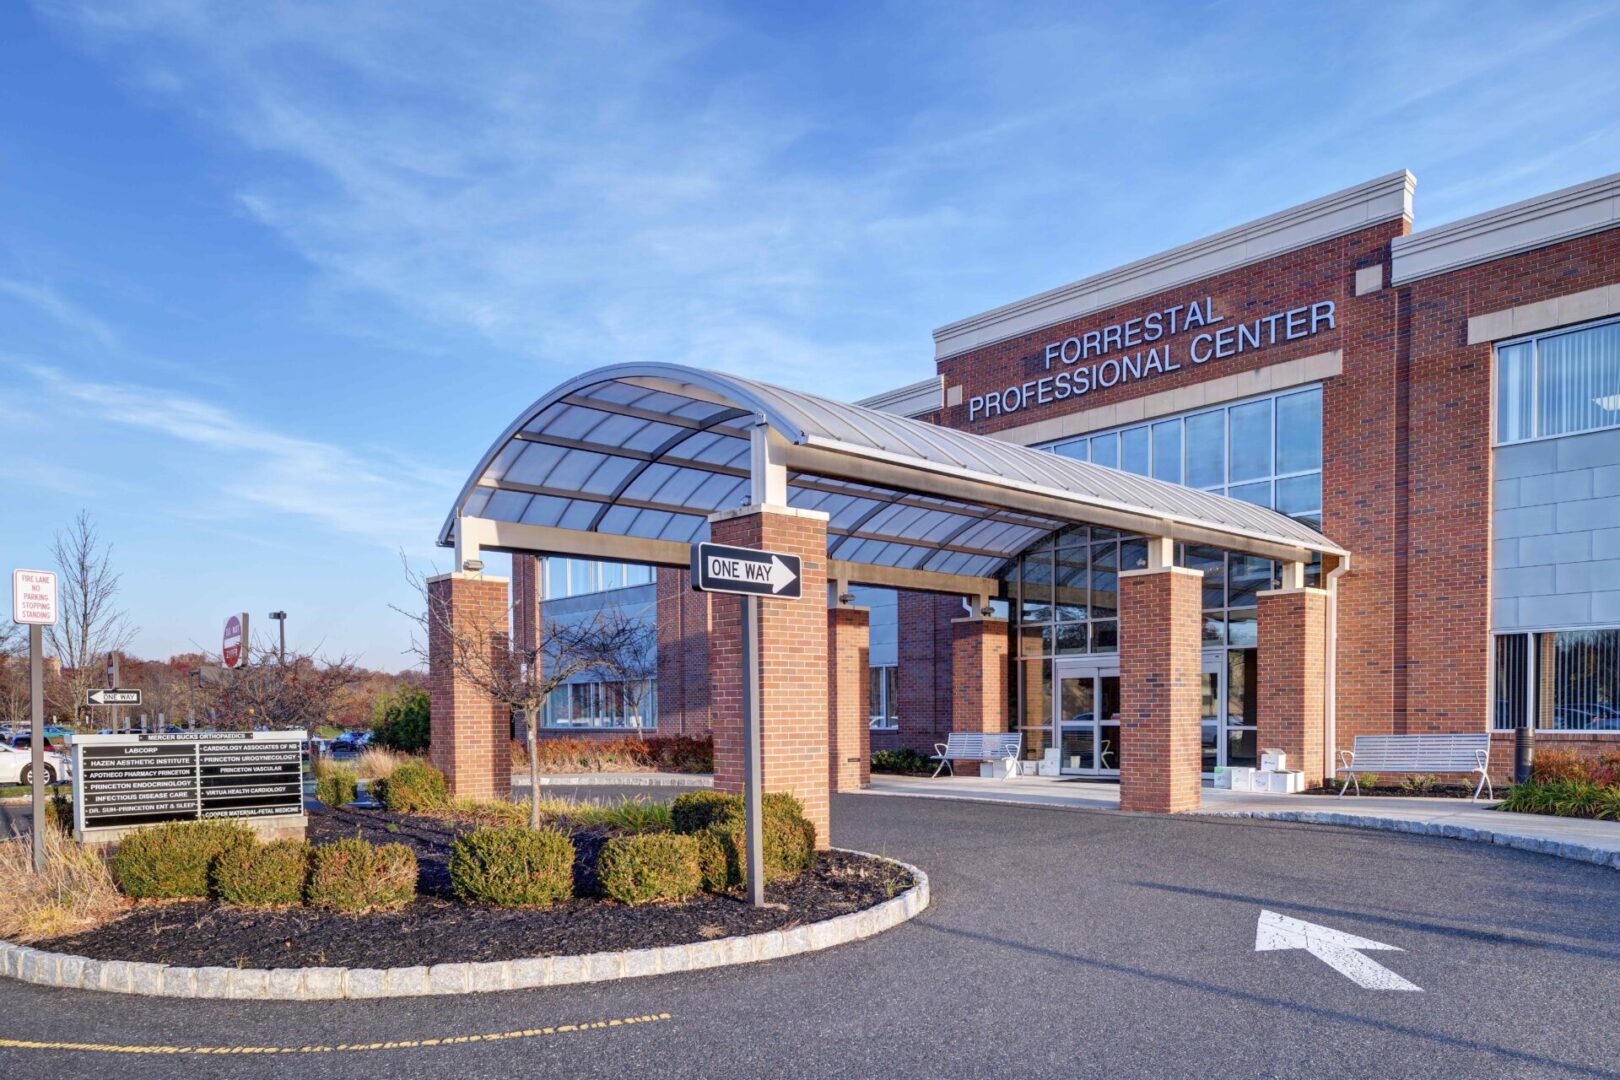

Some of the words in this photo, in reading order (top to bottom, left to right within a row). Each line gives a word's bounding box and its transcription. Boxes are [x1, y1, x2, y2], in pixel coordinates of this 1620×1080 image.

[1045, 296, 1224, 370] FORRESTAL
[969, 344, 1182, 422] PROFESSIONAL
[1190, 300, 1337, 363] CENTER
[712, 559, 740, 578] ONE
[745, 563, 772, 582] WAY
[24, 593, 48, 601] PARKING
[22, 610, 50, 618] STANDING
